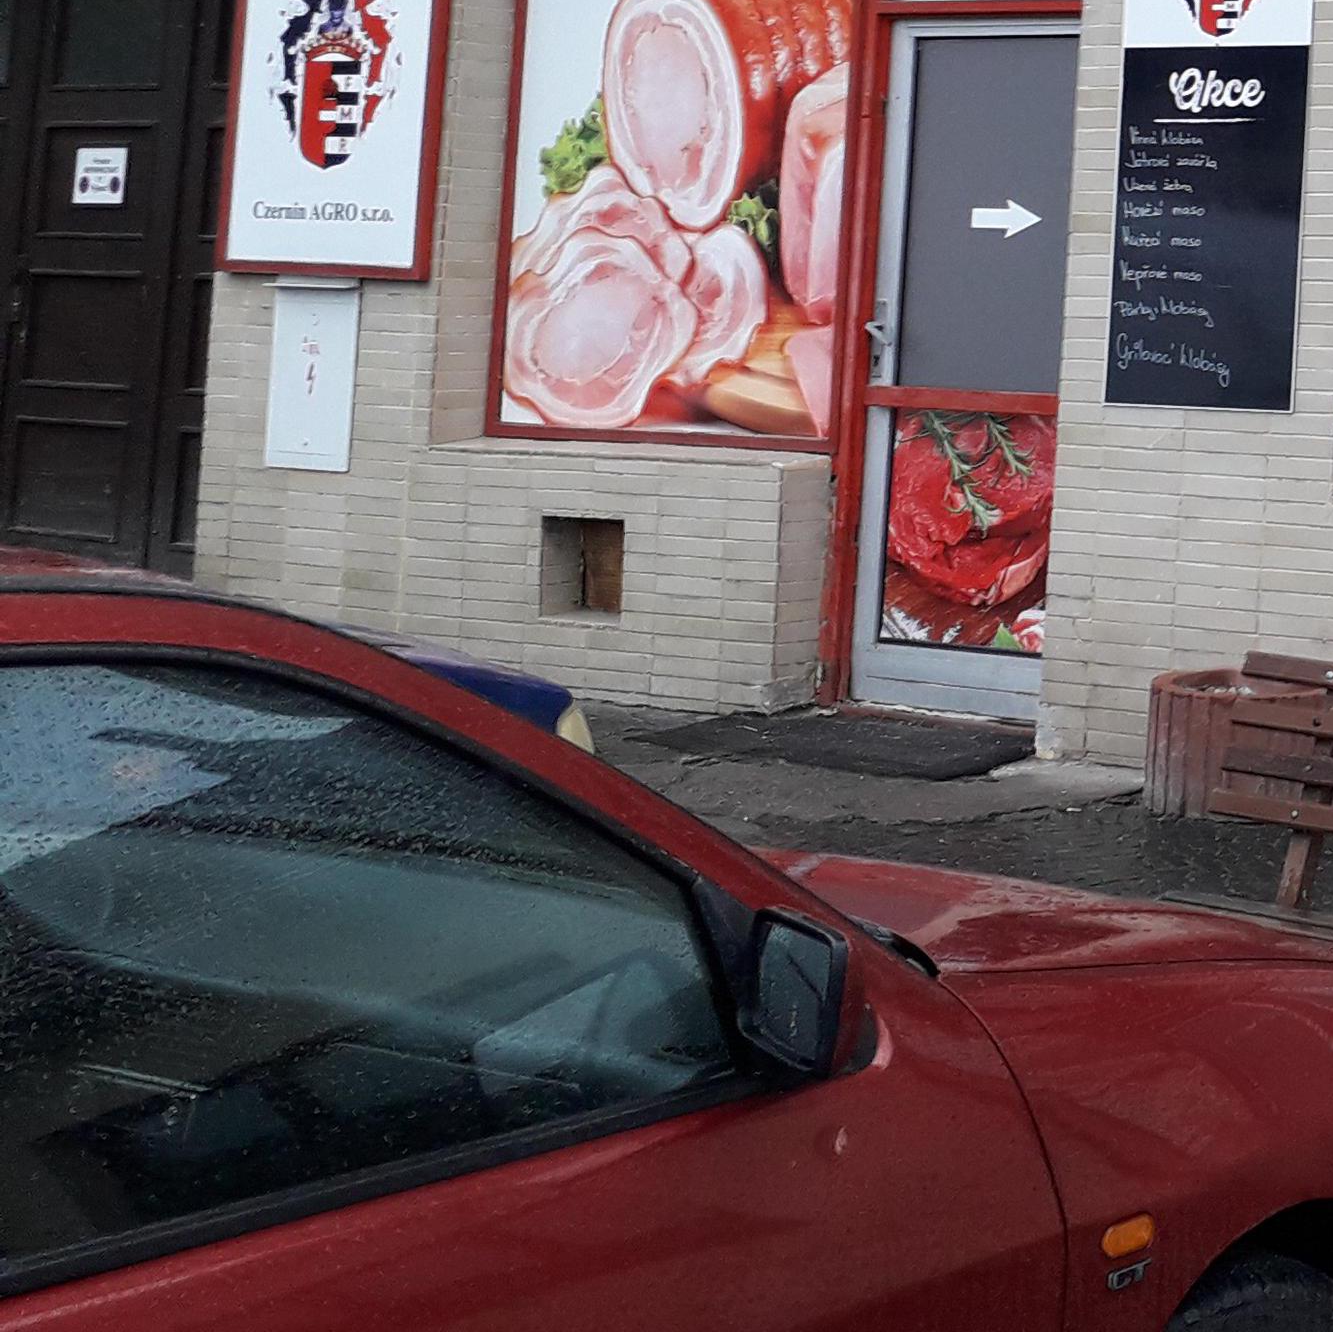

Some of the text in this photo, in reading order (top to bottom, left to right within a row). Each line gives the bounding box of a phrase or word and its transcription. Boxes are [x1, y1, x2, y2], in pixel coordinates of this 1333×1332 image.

[1168, 66, 1266, 113] Akce
[252, 200, 394, 222] Czernin AGRO s.r.o.
[1172, 205, 1206, 217] maso
